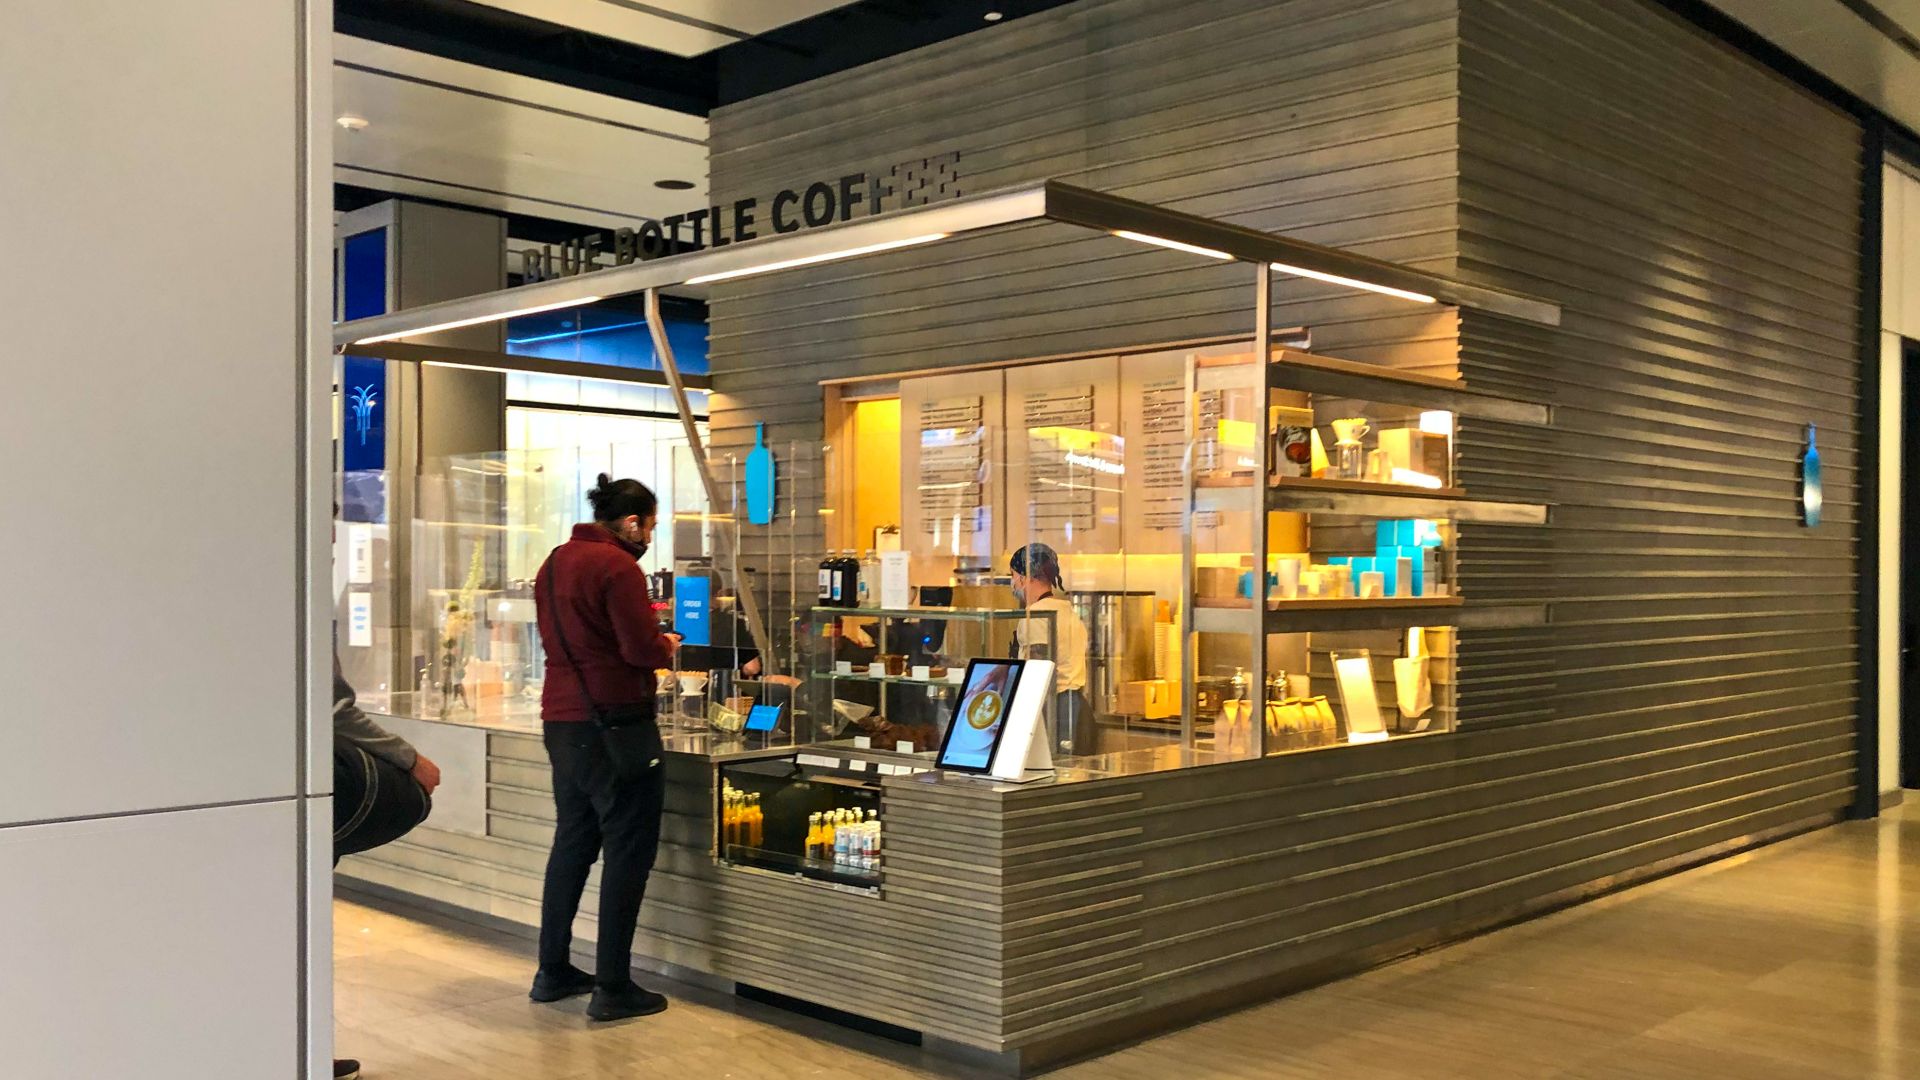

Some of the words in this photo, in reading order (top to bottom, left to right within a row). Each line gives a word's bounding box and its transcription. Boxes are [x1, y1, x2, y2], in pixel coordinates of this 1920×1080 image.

[522, 233, 602, 284] BLUE
[614, 197, 757, 266] BOTTLE
[771, 150, 961, 233] COFFEE
